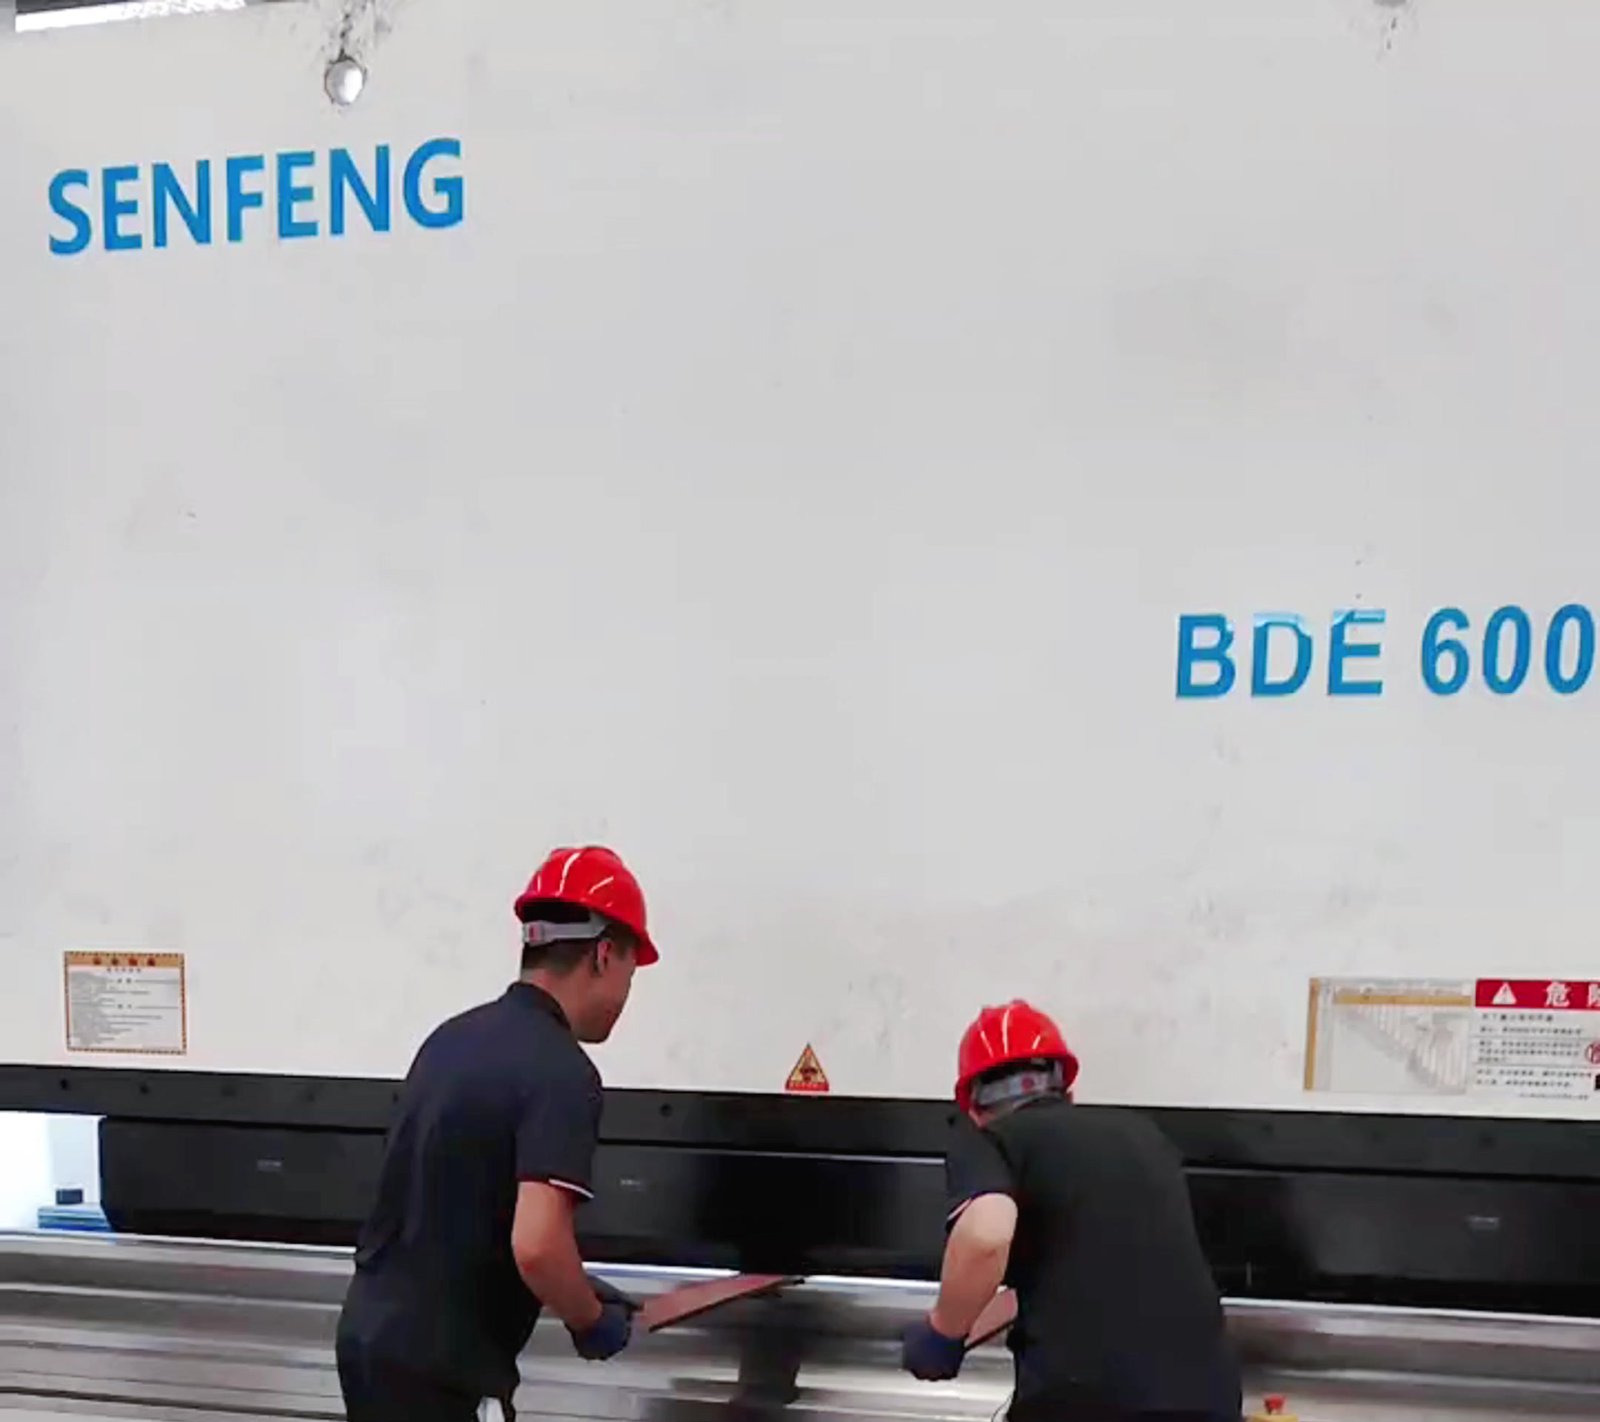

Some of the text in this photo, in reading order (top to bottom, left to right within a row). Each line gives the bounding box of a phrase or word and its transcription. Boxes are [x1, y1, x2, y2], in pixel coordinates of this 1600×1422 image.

[47, 138, 464, 256] SENFENG
[1176, 603, 1596, 697] BDE 600
